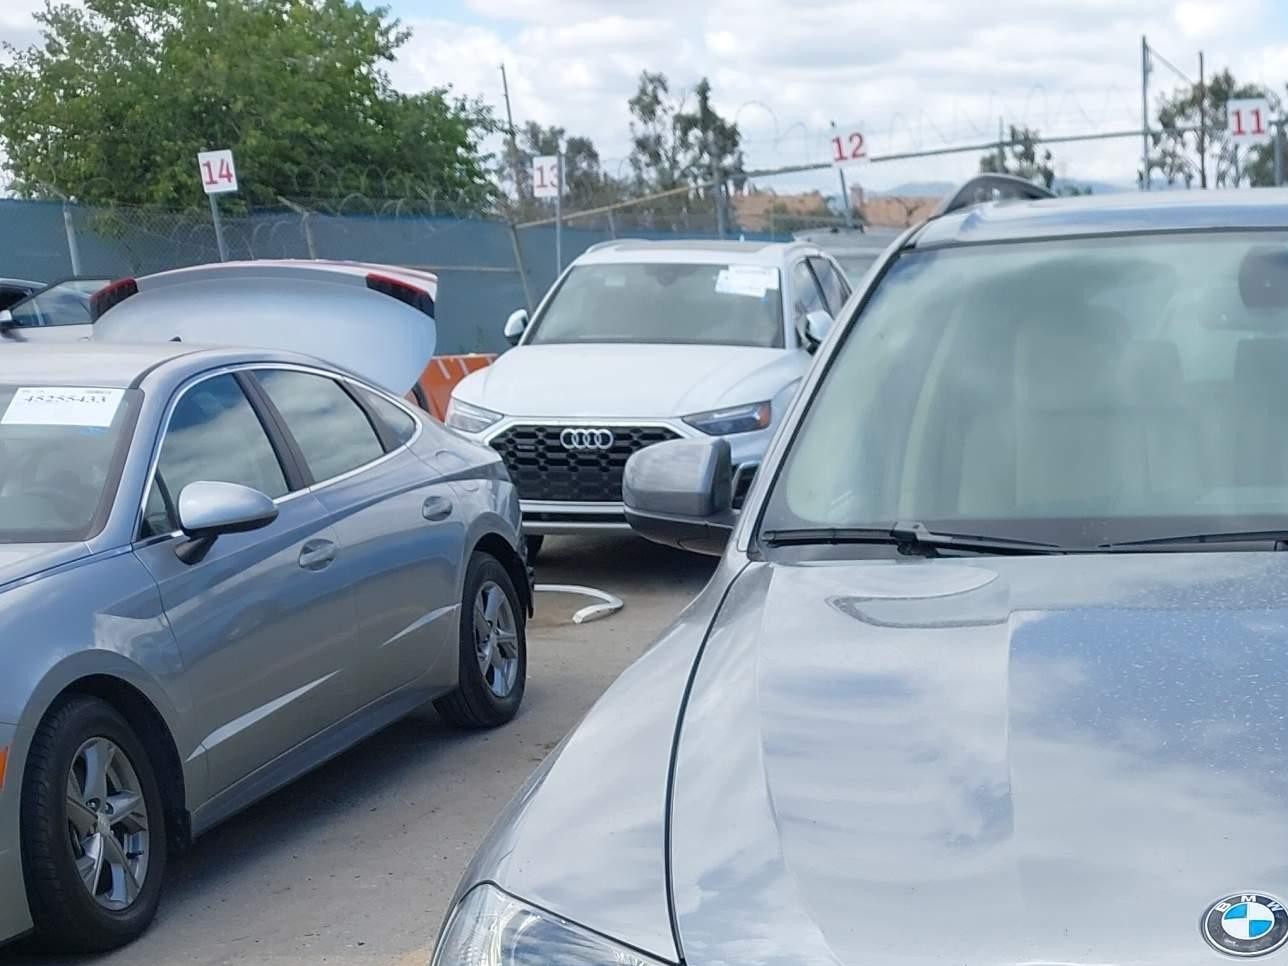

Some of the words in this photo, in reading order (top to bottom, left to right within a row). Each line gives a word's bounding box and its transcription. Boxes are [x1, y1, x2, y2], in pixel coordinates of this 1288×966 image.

[1231, 108, 1265, 137] 11
[831, 132, 866, 162] 12
[202, 158, 234, 185] 14
[1214, 895, 1285, 913] BMW
